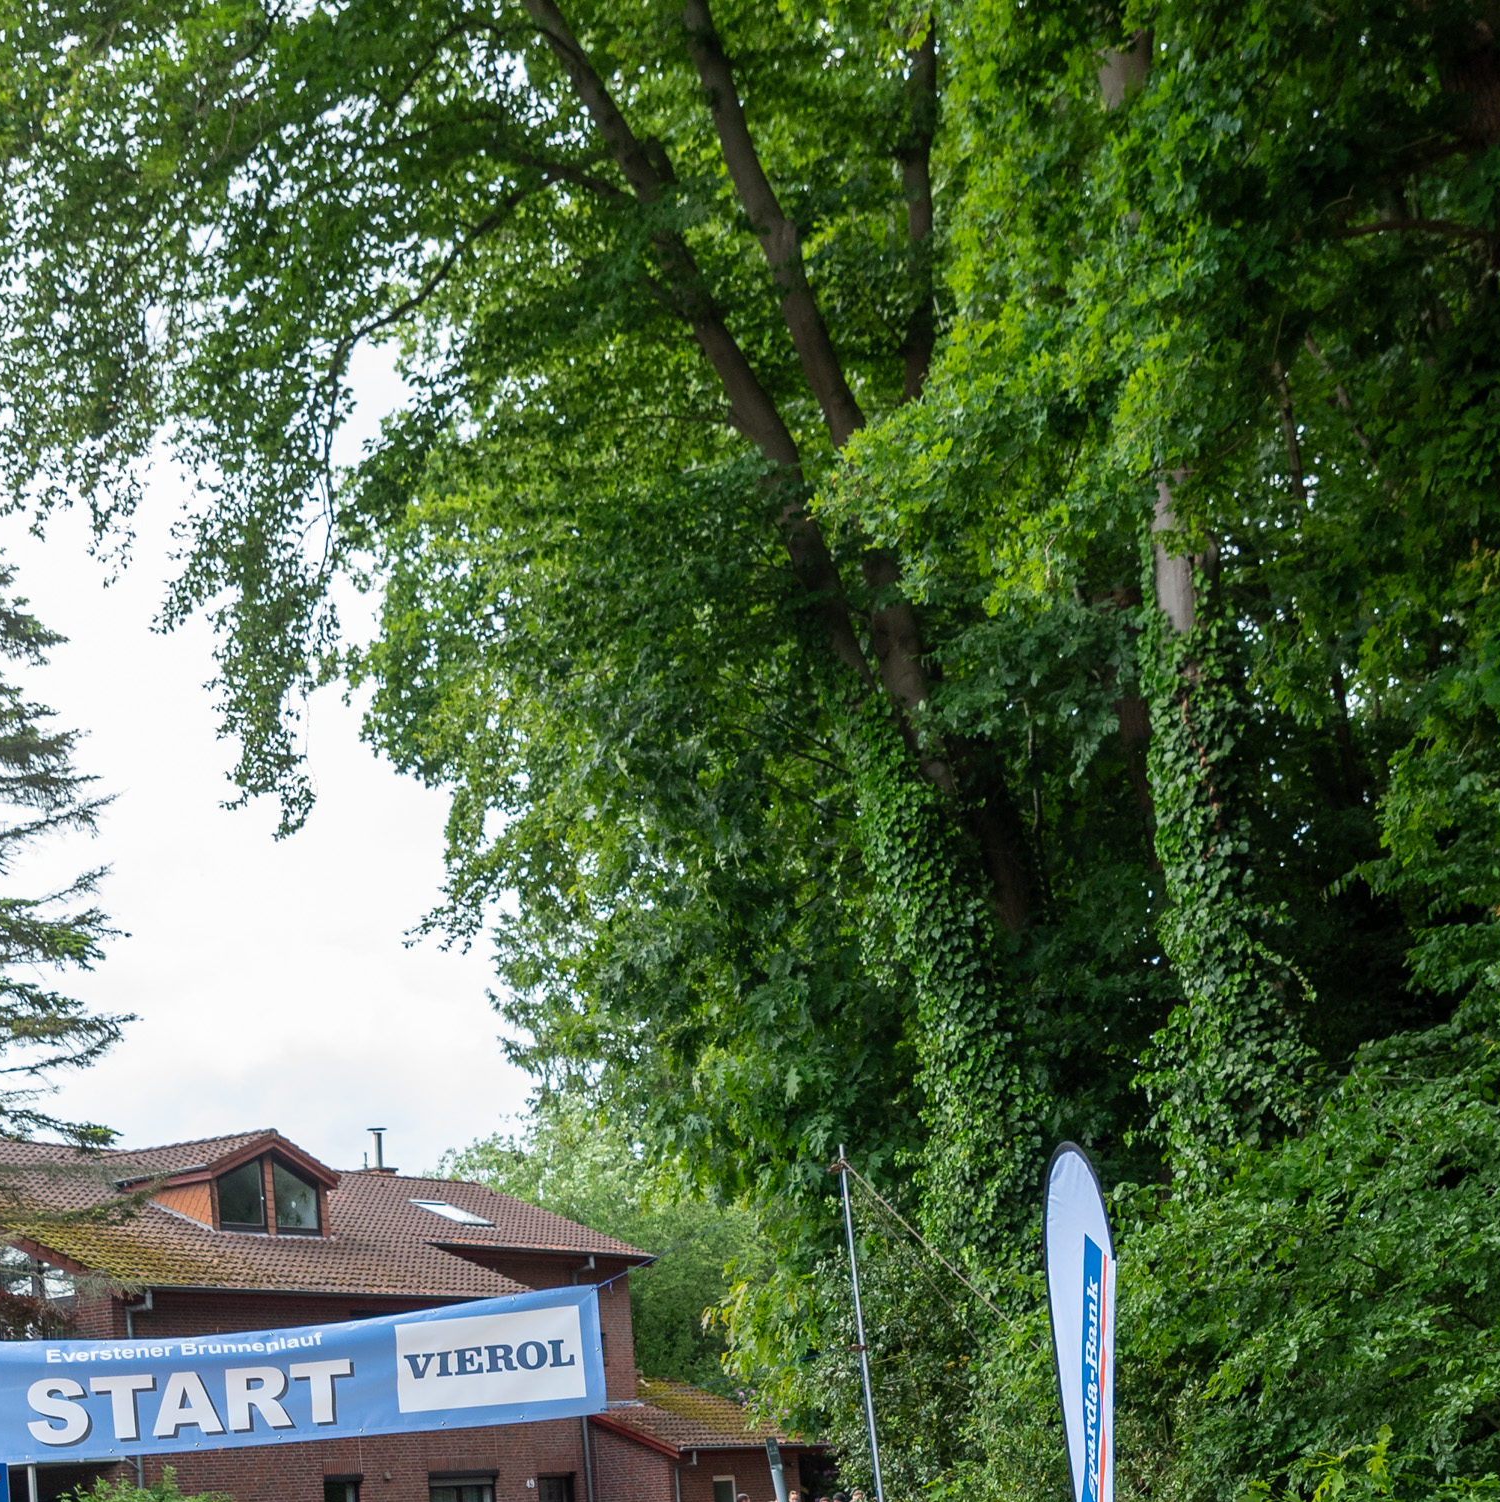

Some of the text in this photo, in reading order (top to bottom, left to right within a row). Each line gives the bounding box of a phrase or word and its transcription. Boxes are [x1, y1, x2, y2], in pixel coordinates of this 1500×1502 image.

[46, 1332, 322, 1363] Everstener Brunnenlauf
[404, 1339, 576, 1379] VIEROL
[27, 1358, 353, 1446] START
